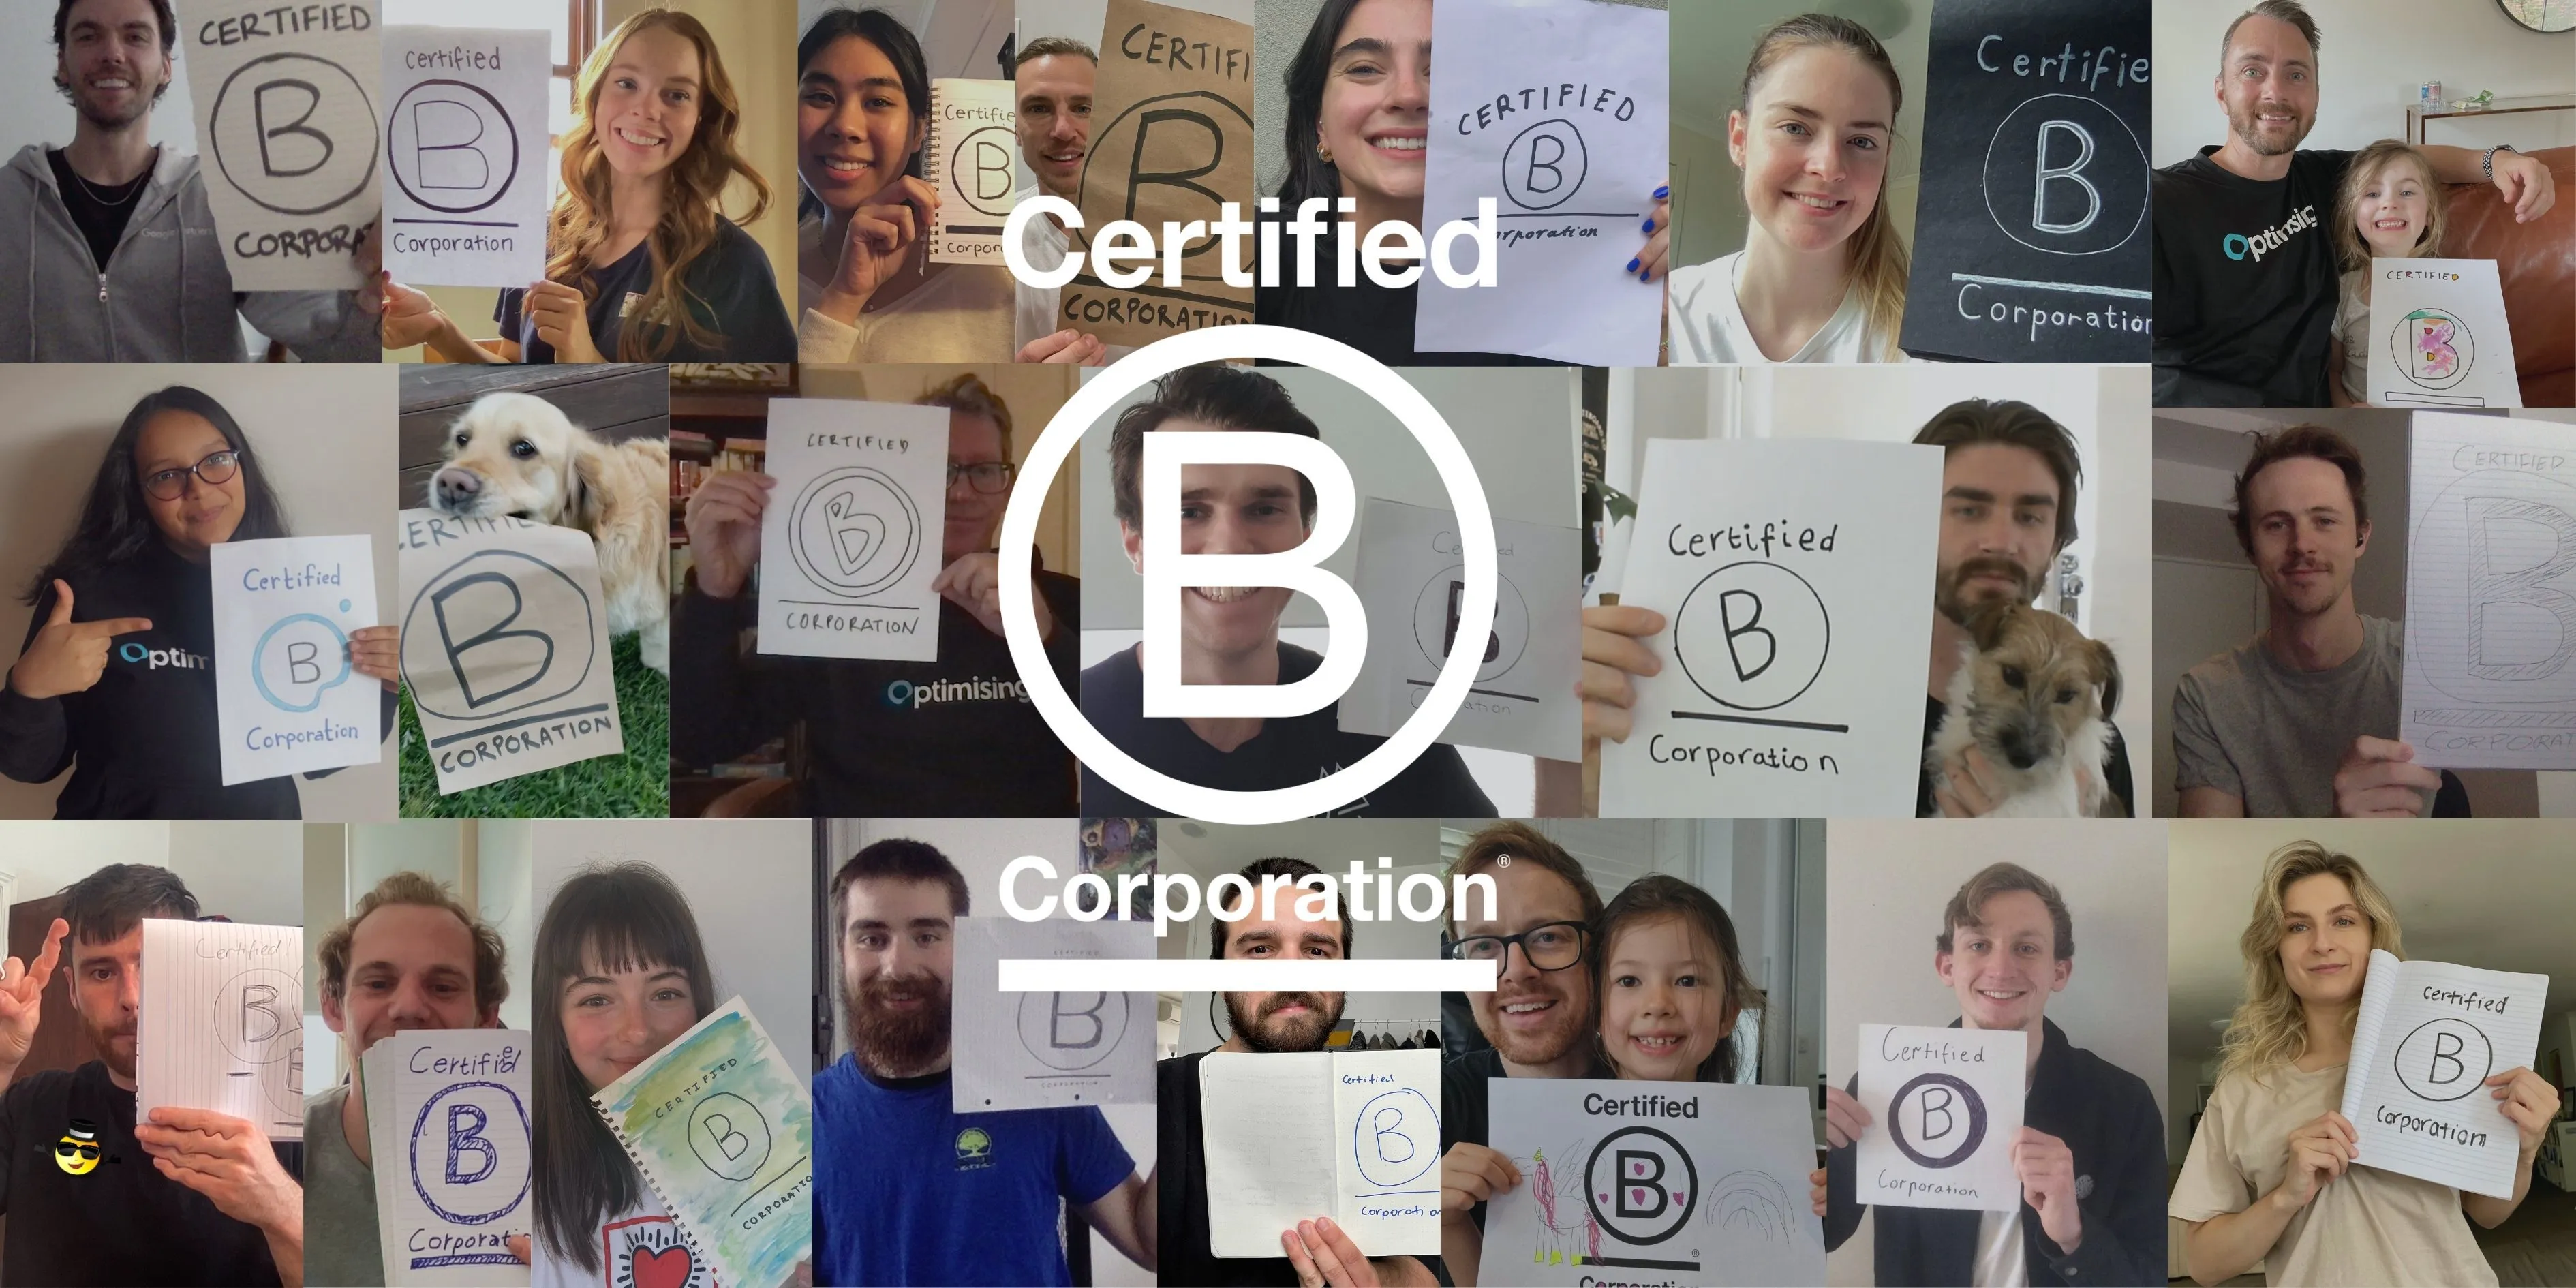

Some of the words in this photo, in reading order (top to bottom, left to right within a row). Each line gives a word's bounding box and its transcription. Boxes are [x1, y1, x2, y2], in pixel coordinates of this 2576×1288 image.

[199, 4, 371, 46] CERTIFIED
[406, 46, 501, 70] Certified
[1121, 23, 1250, 82] CERTIFI
[1976, 35, 2151, 91] Certifie
[254, 79, 333, 177] B
[945, 104, 1015, 123] Certifie
[1458, 83, 1636, 136] CERTIFIED
[414, 100, 489, 189] B
[1527, 134, 1565, 193] B
[976, 142, 1011, 200] B
[2032, 120, 2100, 234] B
[393, 233, 513, 256] Corporation
[947, 242, 1003, 257] Corpor
[2387, 271, 2459, 281] CERTIFIED
[2410, 318, 2459, 379] B
[808, 433, 908, 455] CERTIFIED
[2453, 445, 2564, 472] CERTIFIED
[825, 492, 885, 575] B
[1669, 520, 1837, 558] Certified
[243, 564, 341, 592] Certified
[431, 572, 554, 709] B
[787, 613, 919, 635] CORPORATION
[1720, 589, 1776, 682] B
[288, 642, 321, 684] B
[887, 676, 1032, 709] Optimising
[246, 718, 358, 752] Corporation
[440, 716, 611, 774] CORPORATION
[1649, 735, 1839, 776] Corporation
[241, 985, 280, 1047] B
[2423, 985, 2509, 1015] Certified
[1882, 1026, 1985, 1064] Certified
[2429, 1032, 2464, 1084] B
[655, 1058, 737, 1118] CERTIFIED
[1343, 1075, 1394, 1085] Certified
[1583, 1092, 1698, 1119] Certified
[1922, 1088, 1953, 1141] B
[2376, 1105, 2487, 1148] Corporation
[446, 1104, 497, 1184] B
[703, 1114, 748, 1161] B
[1374, 1108, 1414, 1163] B
[1616, 1150, 1668, 1219] B
[1878, 1169, 1979, 1198] Corporation
